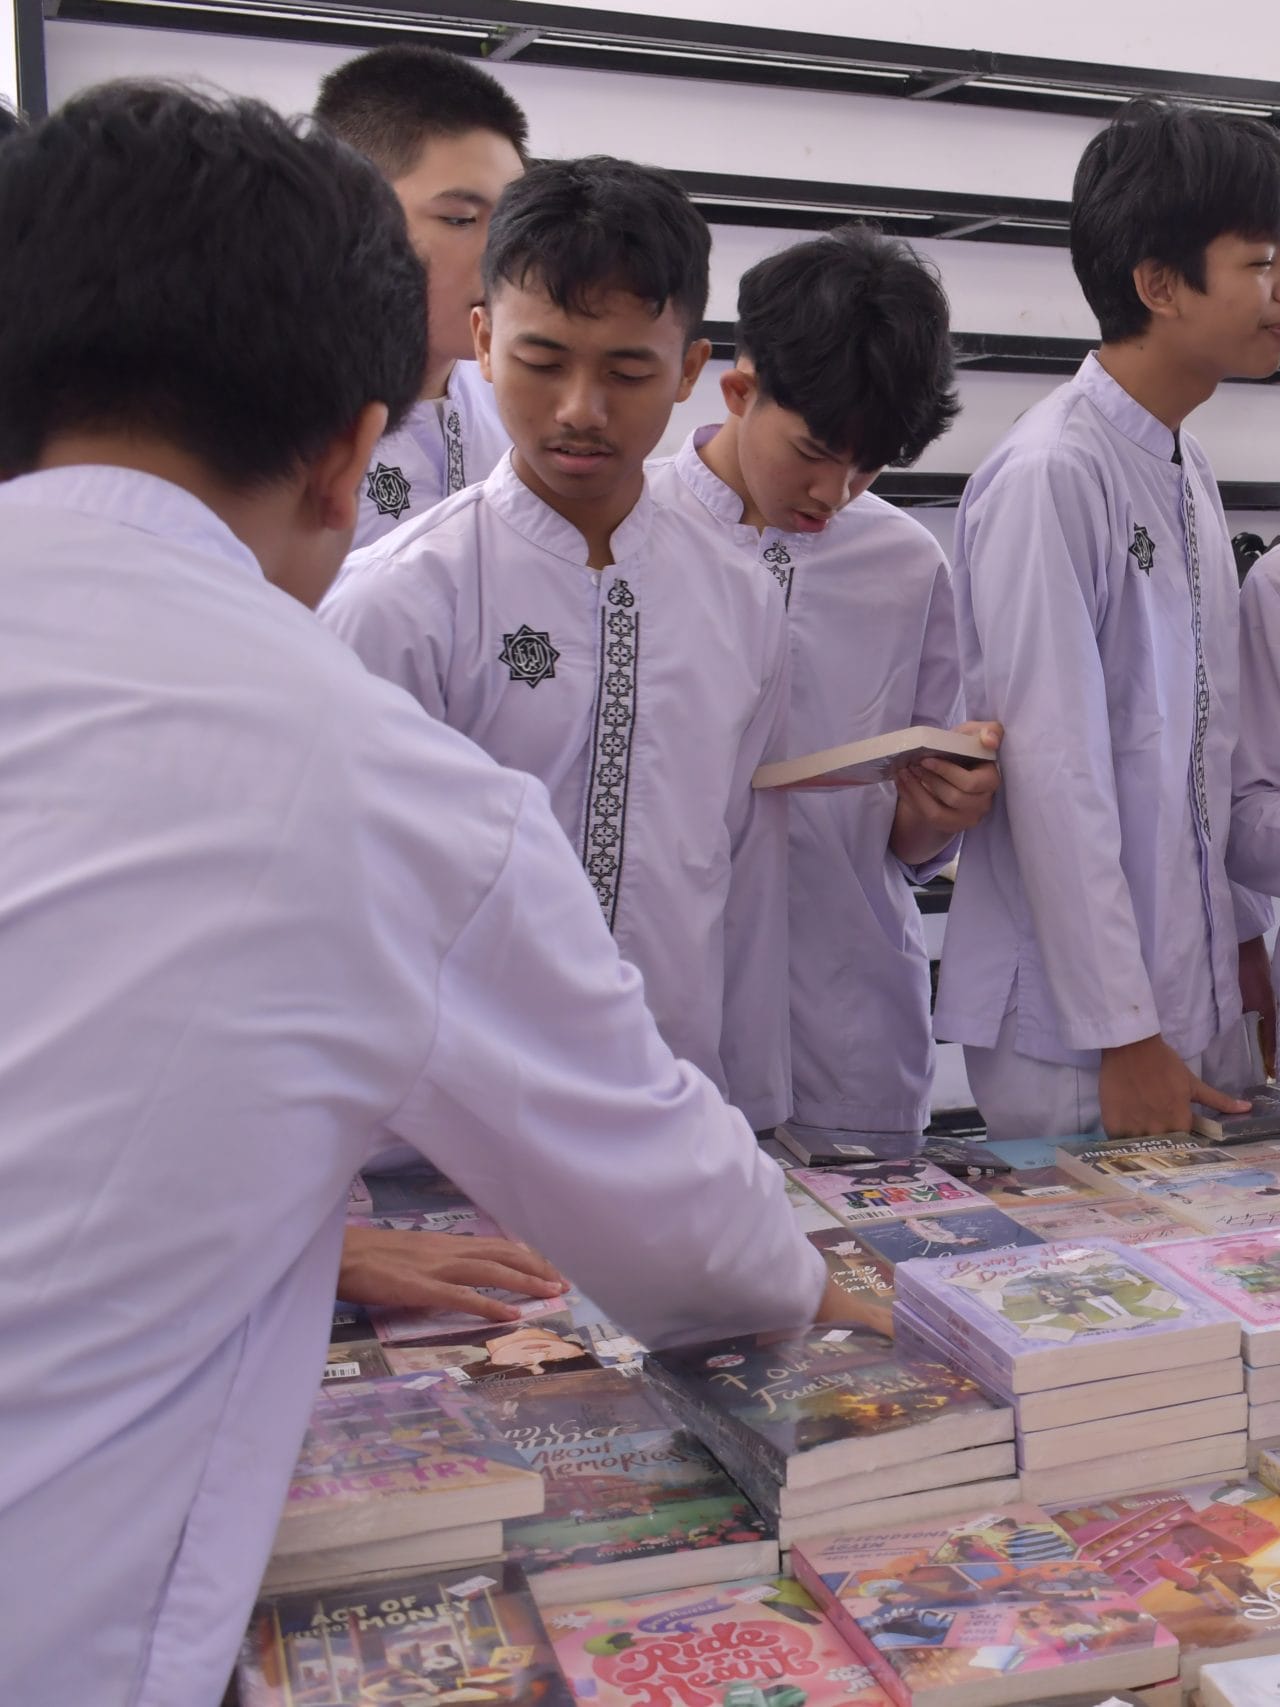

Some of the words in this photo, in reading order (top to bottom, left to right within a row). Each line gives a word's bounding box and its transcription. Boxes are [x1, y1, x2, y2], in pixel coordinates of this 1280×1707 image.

[410, 1457, 491, 1483] TRY
[310, 1606, 368, 1627] ACT
[379, 1595, 418, 1613] OF
[359, 1599, 472, 1632] MONEY
[615, 1620, 780, 1684] Ride
